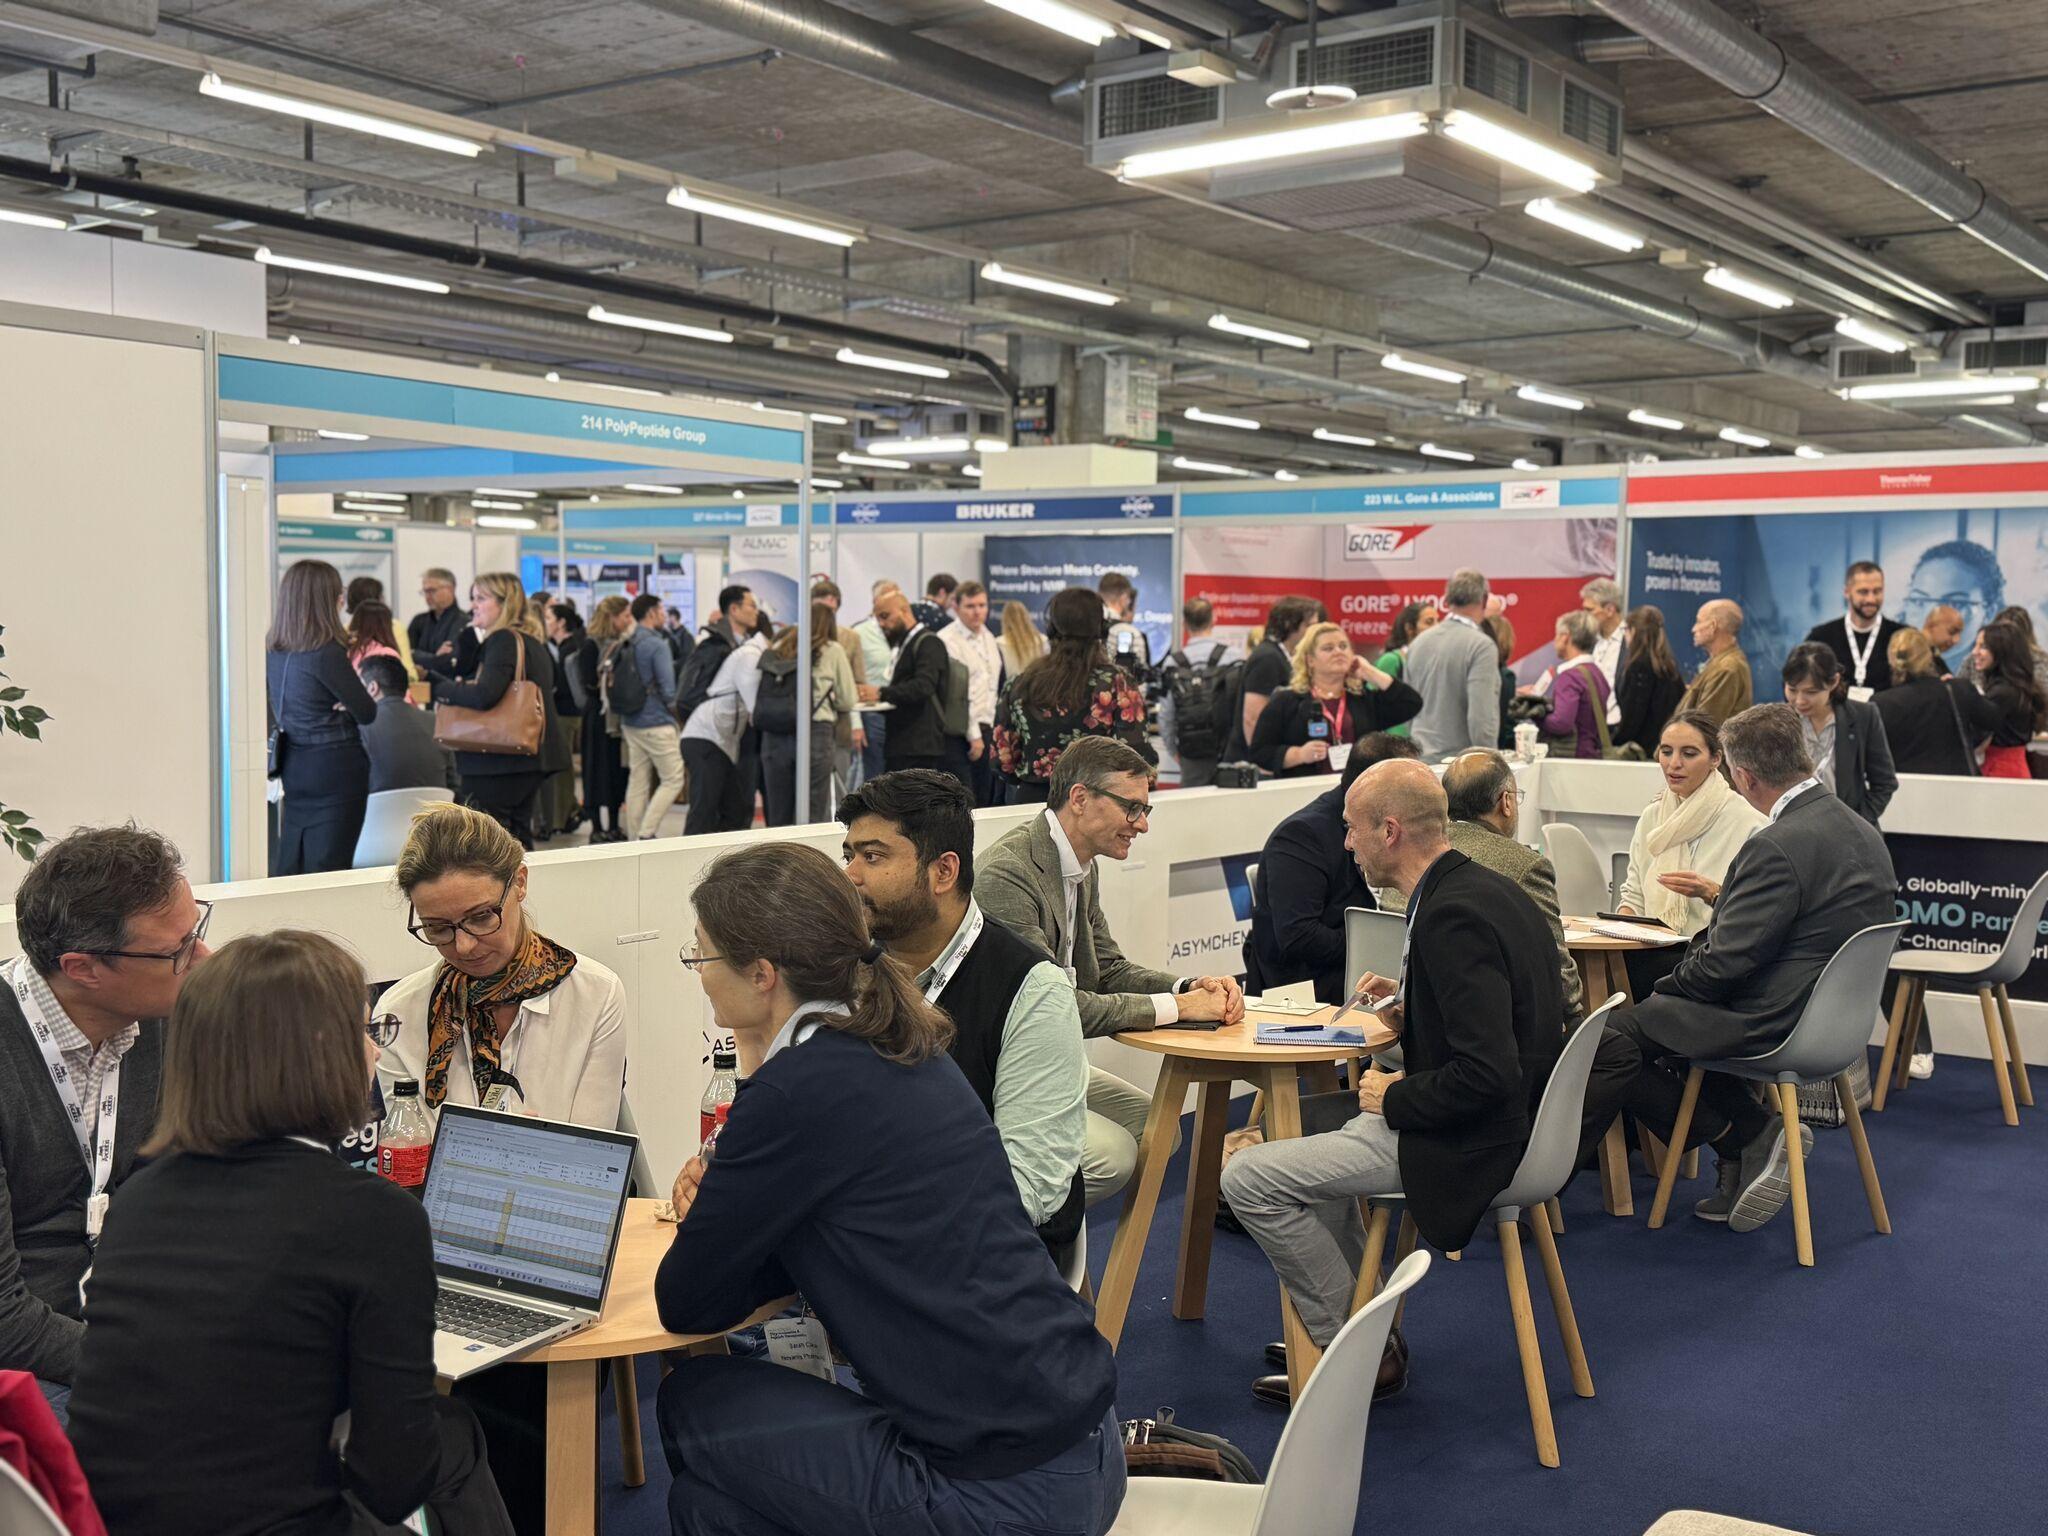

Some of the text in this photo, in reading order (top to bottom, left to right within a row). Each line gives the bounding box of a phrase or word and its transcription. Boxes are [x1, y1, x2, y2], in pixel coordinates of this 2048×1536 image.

[581, 414, 706, 446] 214 PolyPeptide Group
[1404, 491, 1429, 504] Gore
[1440, 489, 1495, 503] Associates
[955, 502, 1035, 520] BRUKER
[1348, 533, 1394, 552] GORE
[1906, 876, 2029, 901] Globally-min
